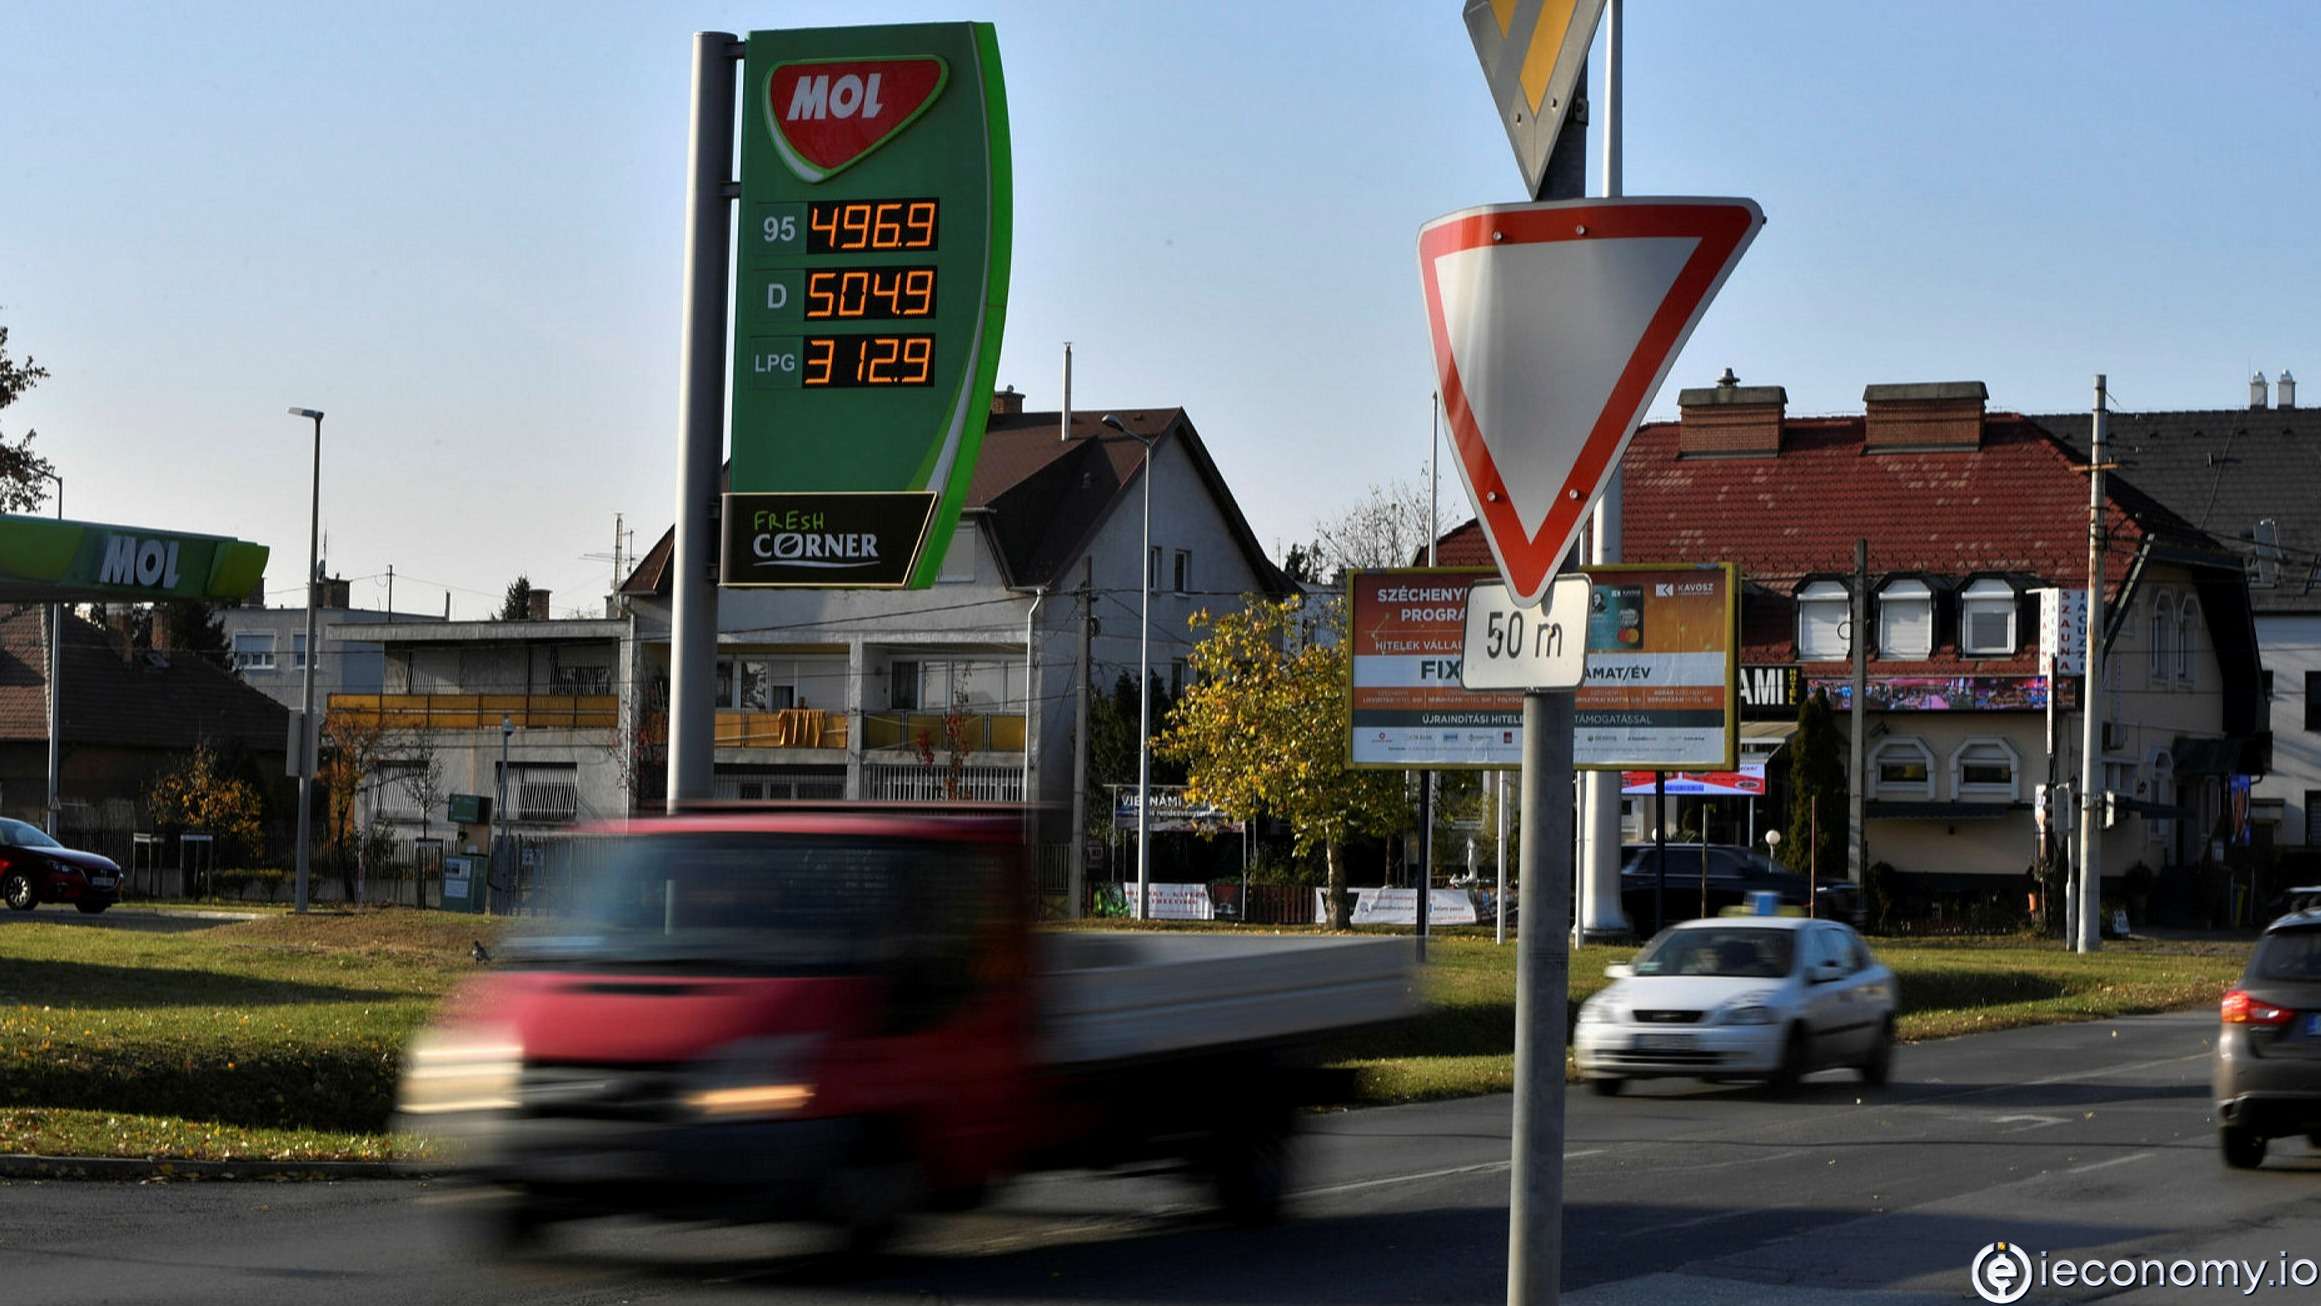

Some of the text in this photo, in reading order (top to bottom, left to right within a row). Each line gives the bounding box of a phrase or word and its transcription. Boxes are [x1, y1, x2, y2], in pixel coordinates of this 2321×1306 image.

[786, 73, 884, 121] MOL
[763, 203, 936, 249] 95 496.9
[767, 271, 934, 317] D 504.9
[755, 338, 932, 385] LPG 312.9
[100, 535, 181, 589] MOL
[753, 532, 880, 558] CORNER
[1486, 611, 1563, 659] 50 m
[2060, 591, 2070, 670] SZAUNA
[1421, 660, 1462, 680] FIX
[1121, 792, 1182, 807] VIENÁMI
